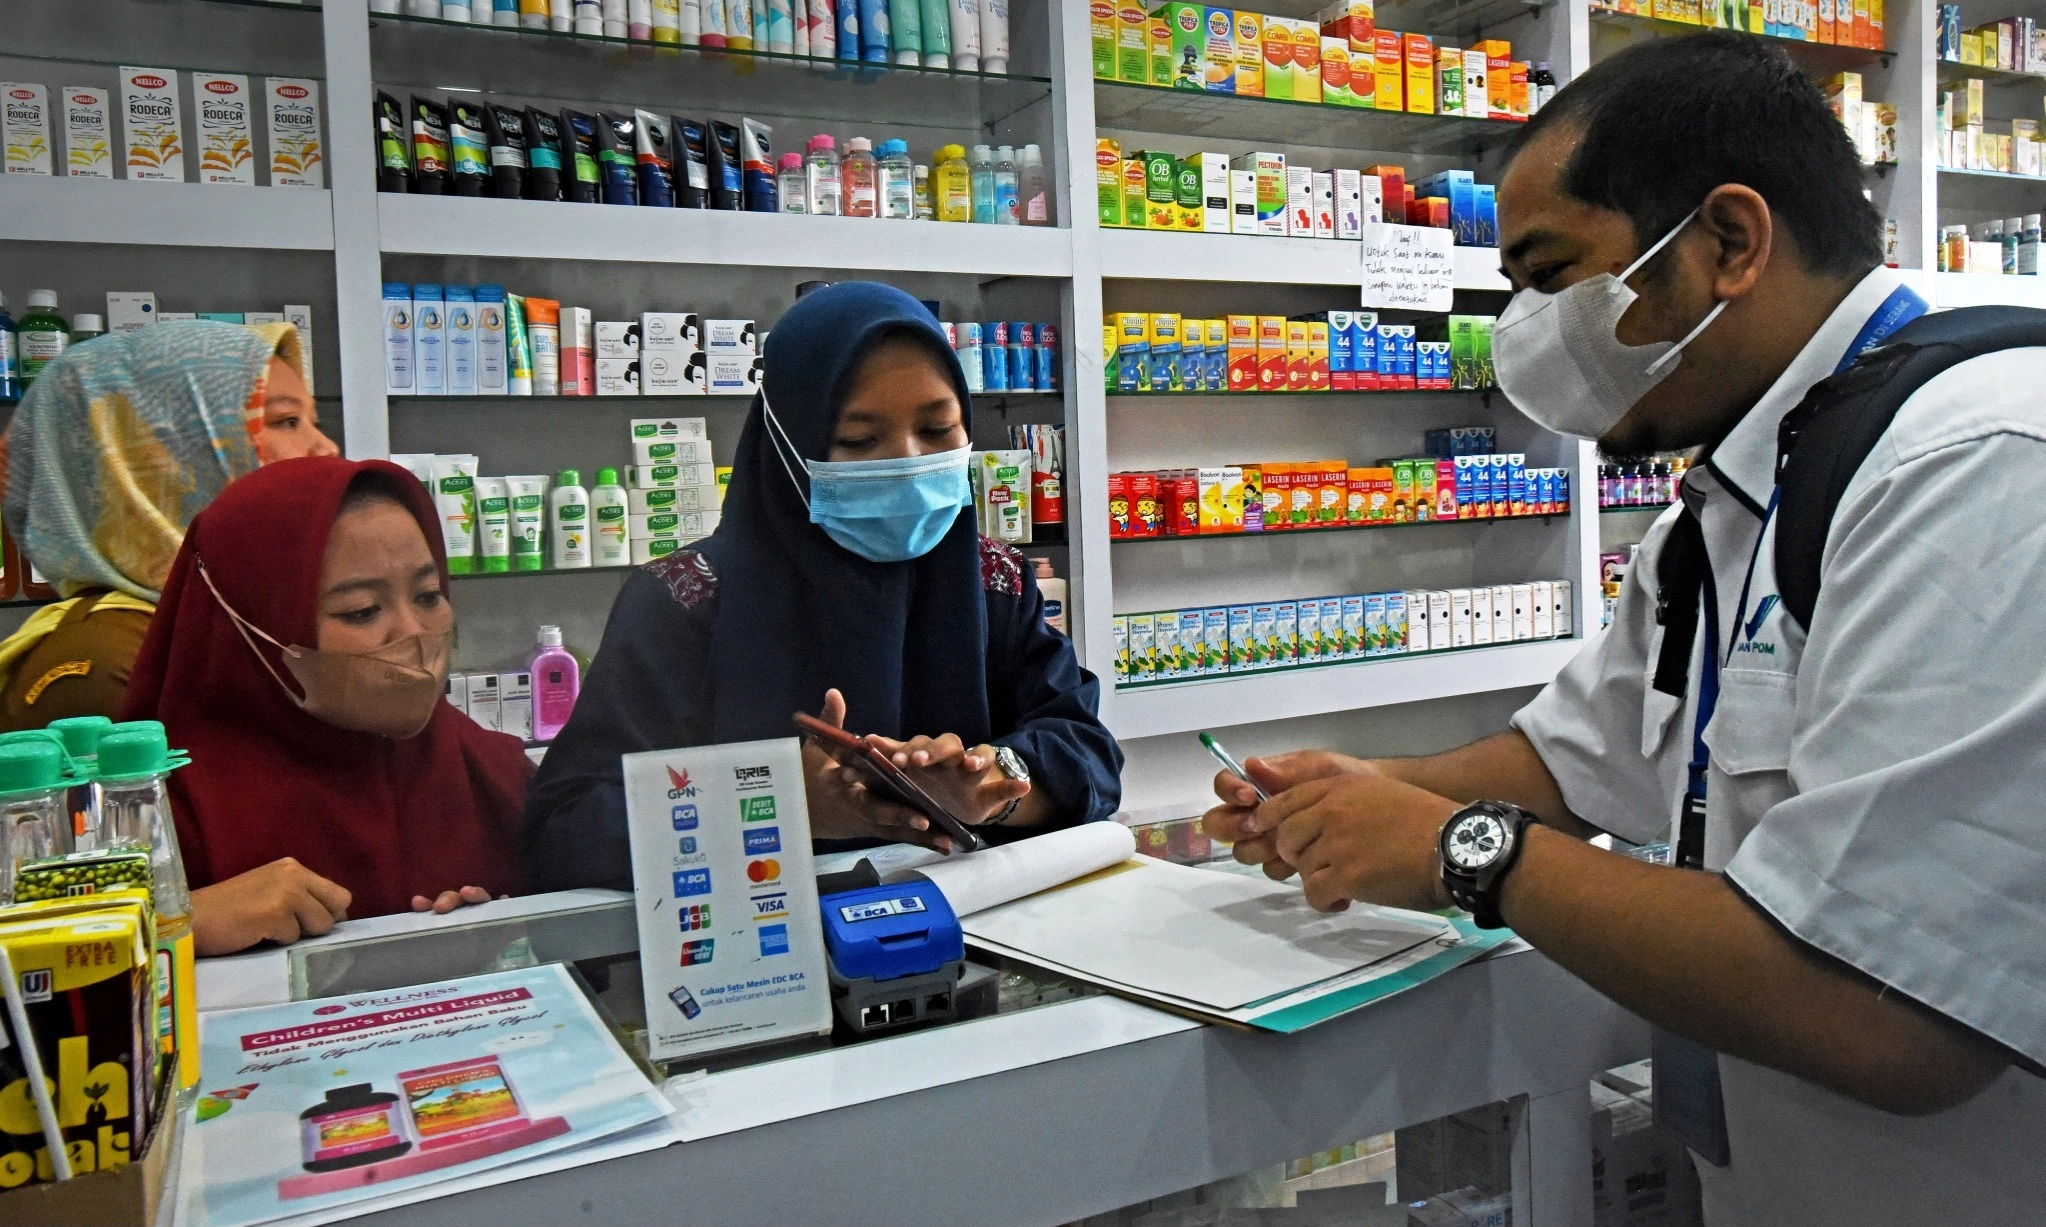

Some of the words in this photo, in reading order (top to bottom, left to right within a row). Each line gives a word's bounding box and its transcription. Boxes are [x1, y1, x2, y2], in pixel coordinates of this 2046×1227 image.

[1210, 20, 1228, 28] TROPICA
[1268, 33, 1288, 41] COMBI
[1296, 36, 1316, 44] COMBI
[1488, 59, 1510, 68] LASERIN
[135, 78, 163, 88] NELLCO
[1511, 74, 1527, 82] LASERIN
[208, 84, 236, 92] NELLCO
[280, 88, 307, 96] NELLCO
[12, 90, 33, 98] NELLCO
[8, 110, 39, 120] RODECA
[130, 104, 171, 116] RODECA
[70, 115, 101, 124] RODECA
[203, 110, 243, 121] RODECA
[274, 113, 312, 124] RODECA
[500, 121, 523, 134] MEN
[538, 122, 558, 137] MEN
[1152, 164, 1170, 175] OB
[1258, 161, 1282, 170] PECTORIN
[1181, 174, 1196, 184] OB
[1366, 245, 1389, 258] Untuk
[1366, 260, 1386, 274] Tidak
[1122, 317, 1145, 326] WOODS
[1154, 318, 1177, 327] WOODS
[1337, 336, 1350, 348] 44
[1362, 336, 1375, 348] 44
[1383, 342, 1396, 352] 44
[1402, 342, 1414, 352] 44
[1422, 358, 1432, 366] 44
[1438, 358, 1448, 366] 44
[715, 366, 740, 374] DREAM
[1292, 474, 1318, 483] LASERIN
[1321, 473, 1346, 482] LASERIN
[1397, 469, 1410, 479] OB
[1420, 469, 1432, 479] OB
[1460, 472, 1471, 482] 44
[1478, 472, 1489, 480] 44
[1496, 471, 1507, 480] 44
[1513, 470, 1524, 479] 44
[1264, 476, 1290, 484] LASERIN
[1544, 483, 1552, 491] 44
[1752, 642, 1775, 654] POM
[735, 766, 770, 781] QRIS
[667, 787, 696, 800] GPN
[752, 800, 772, 808] DEBIT
[674, 808, 696, 820] BCA
[758, 808, 774, 816] BCA
[748, 836, 776, 845] PRIMA
[688, 874, 706, 884] BCA
[750, 881, 781, 890] mastercard
[756, 900, 785, 912] VISA
[864, 908, 888, 917] BCA
[680, 912, 710, 924] JCB
[66, 941, 114, 957] EXTRA
[683, 944, 712, 955] UnionPay
[66, 950, 116, 968] FREE
[700, 986, 725, 997] Cukup
[727, 984, 745, 992] Satu
[746, 980, 770, 988] Mesin
[772, 975, 788, 984] EDC
[789, 972, 805, 981] BCA
[348, 987, 460, 1006] WELLNESS
[702, 998, 723, 1008] untuk
[725, 992, 764, 1003] kelancaran
[766, 987, 786, 996] usaha
[788, 984, 806, 993] anda
[250, 1016, 376, 1045] Children's
[382, 1003, 443, 1022] Multi
[450, 990, 520, 1010] Liquid
[253, 1044, 301, 1057] Tidak
[307, 1021, 430, 1048] Menggunakan
[434, 1010, 483, 1026] Bahan
[488, 1004, 527, 1016] Baku
[236, 1055, 309, 1076] Ethylene
[320, 1042, 378, 1060] Glycol
[378, 1038, 401, 1048] dan
[410, 1022, 490, 1042] Diethylene
[498, 1010, 548, 1028] Glycol
